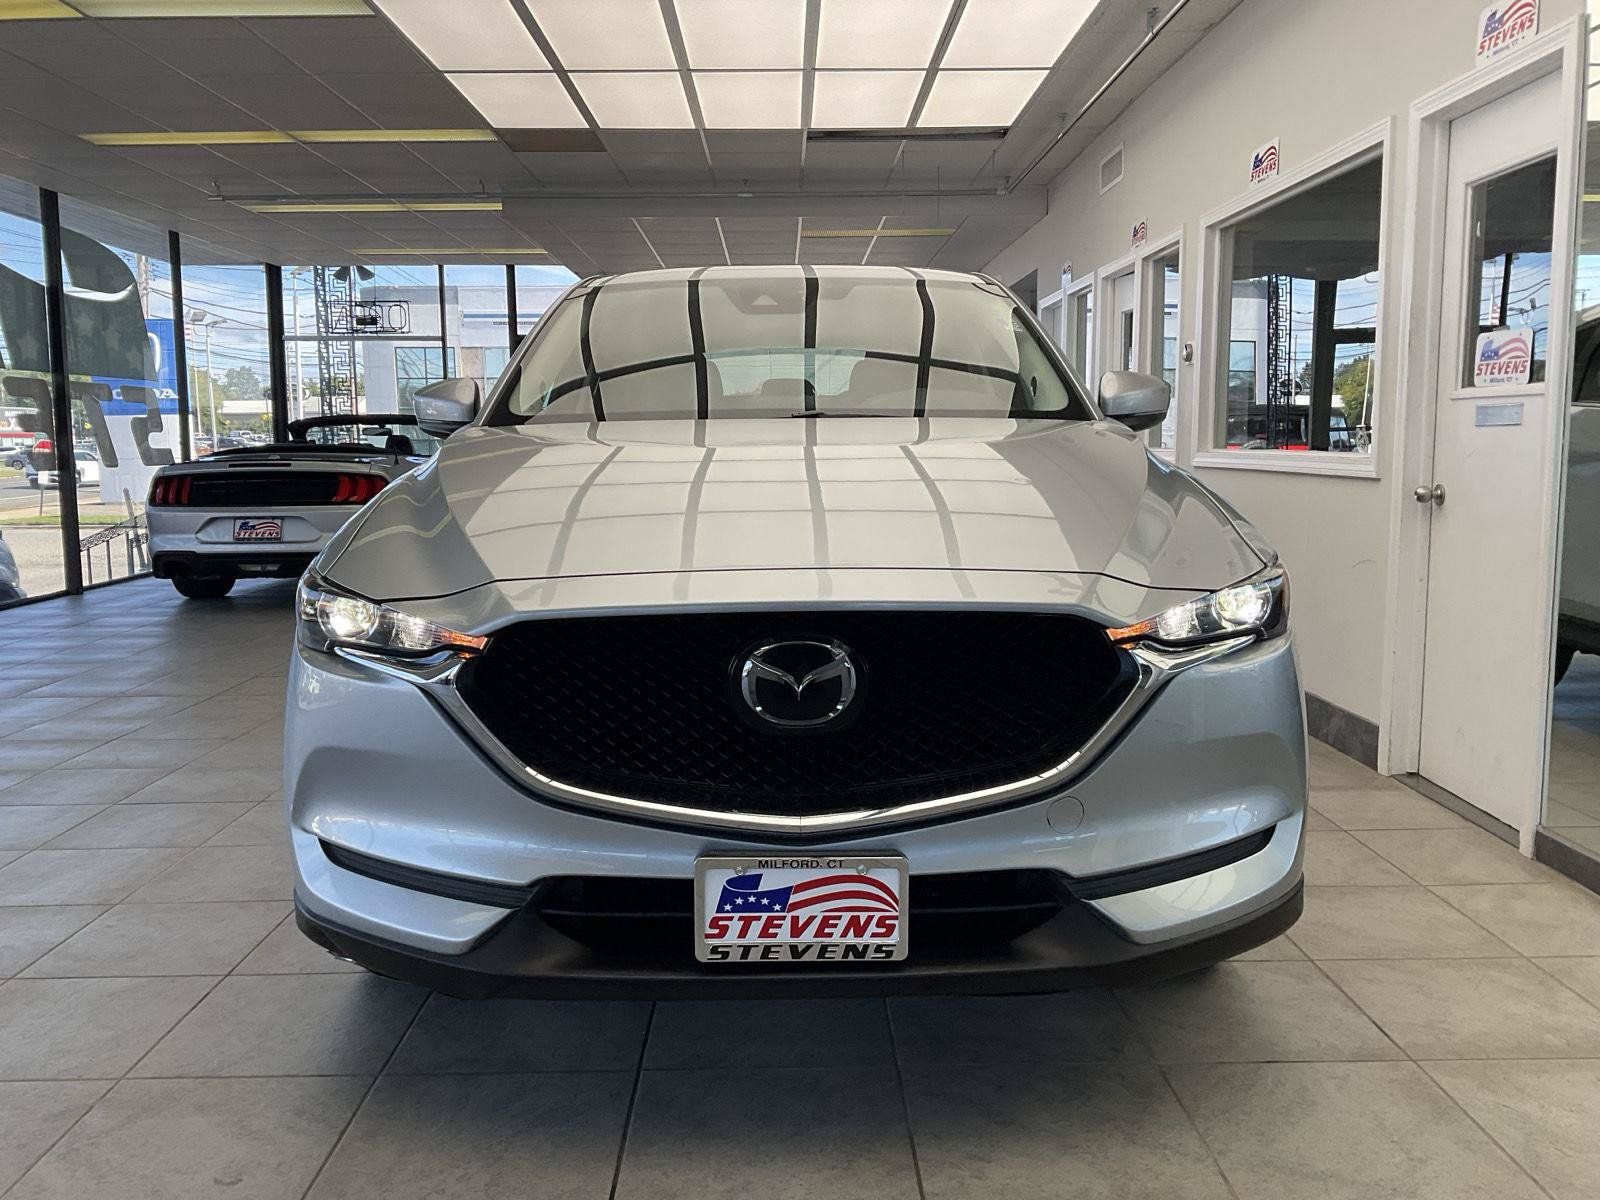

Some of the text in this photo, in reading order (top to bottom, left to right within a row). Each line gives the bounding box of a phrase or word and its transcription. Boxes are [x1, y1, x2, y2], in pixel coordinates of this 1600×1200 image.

[1477, 11, 1537, 56] STEVENS
[1475, 359, 1528, 376] STEVENS
[827, 859, 845, 869] CT
[704, 914, 899, 939] STEVENS
[706, 944, 897, 961] STEVENS
